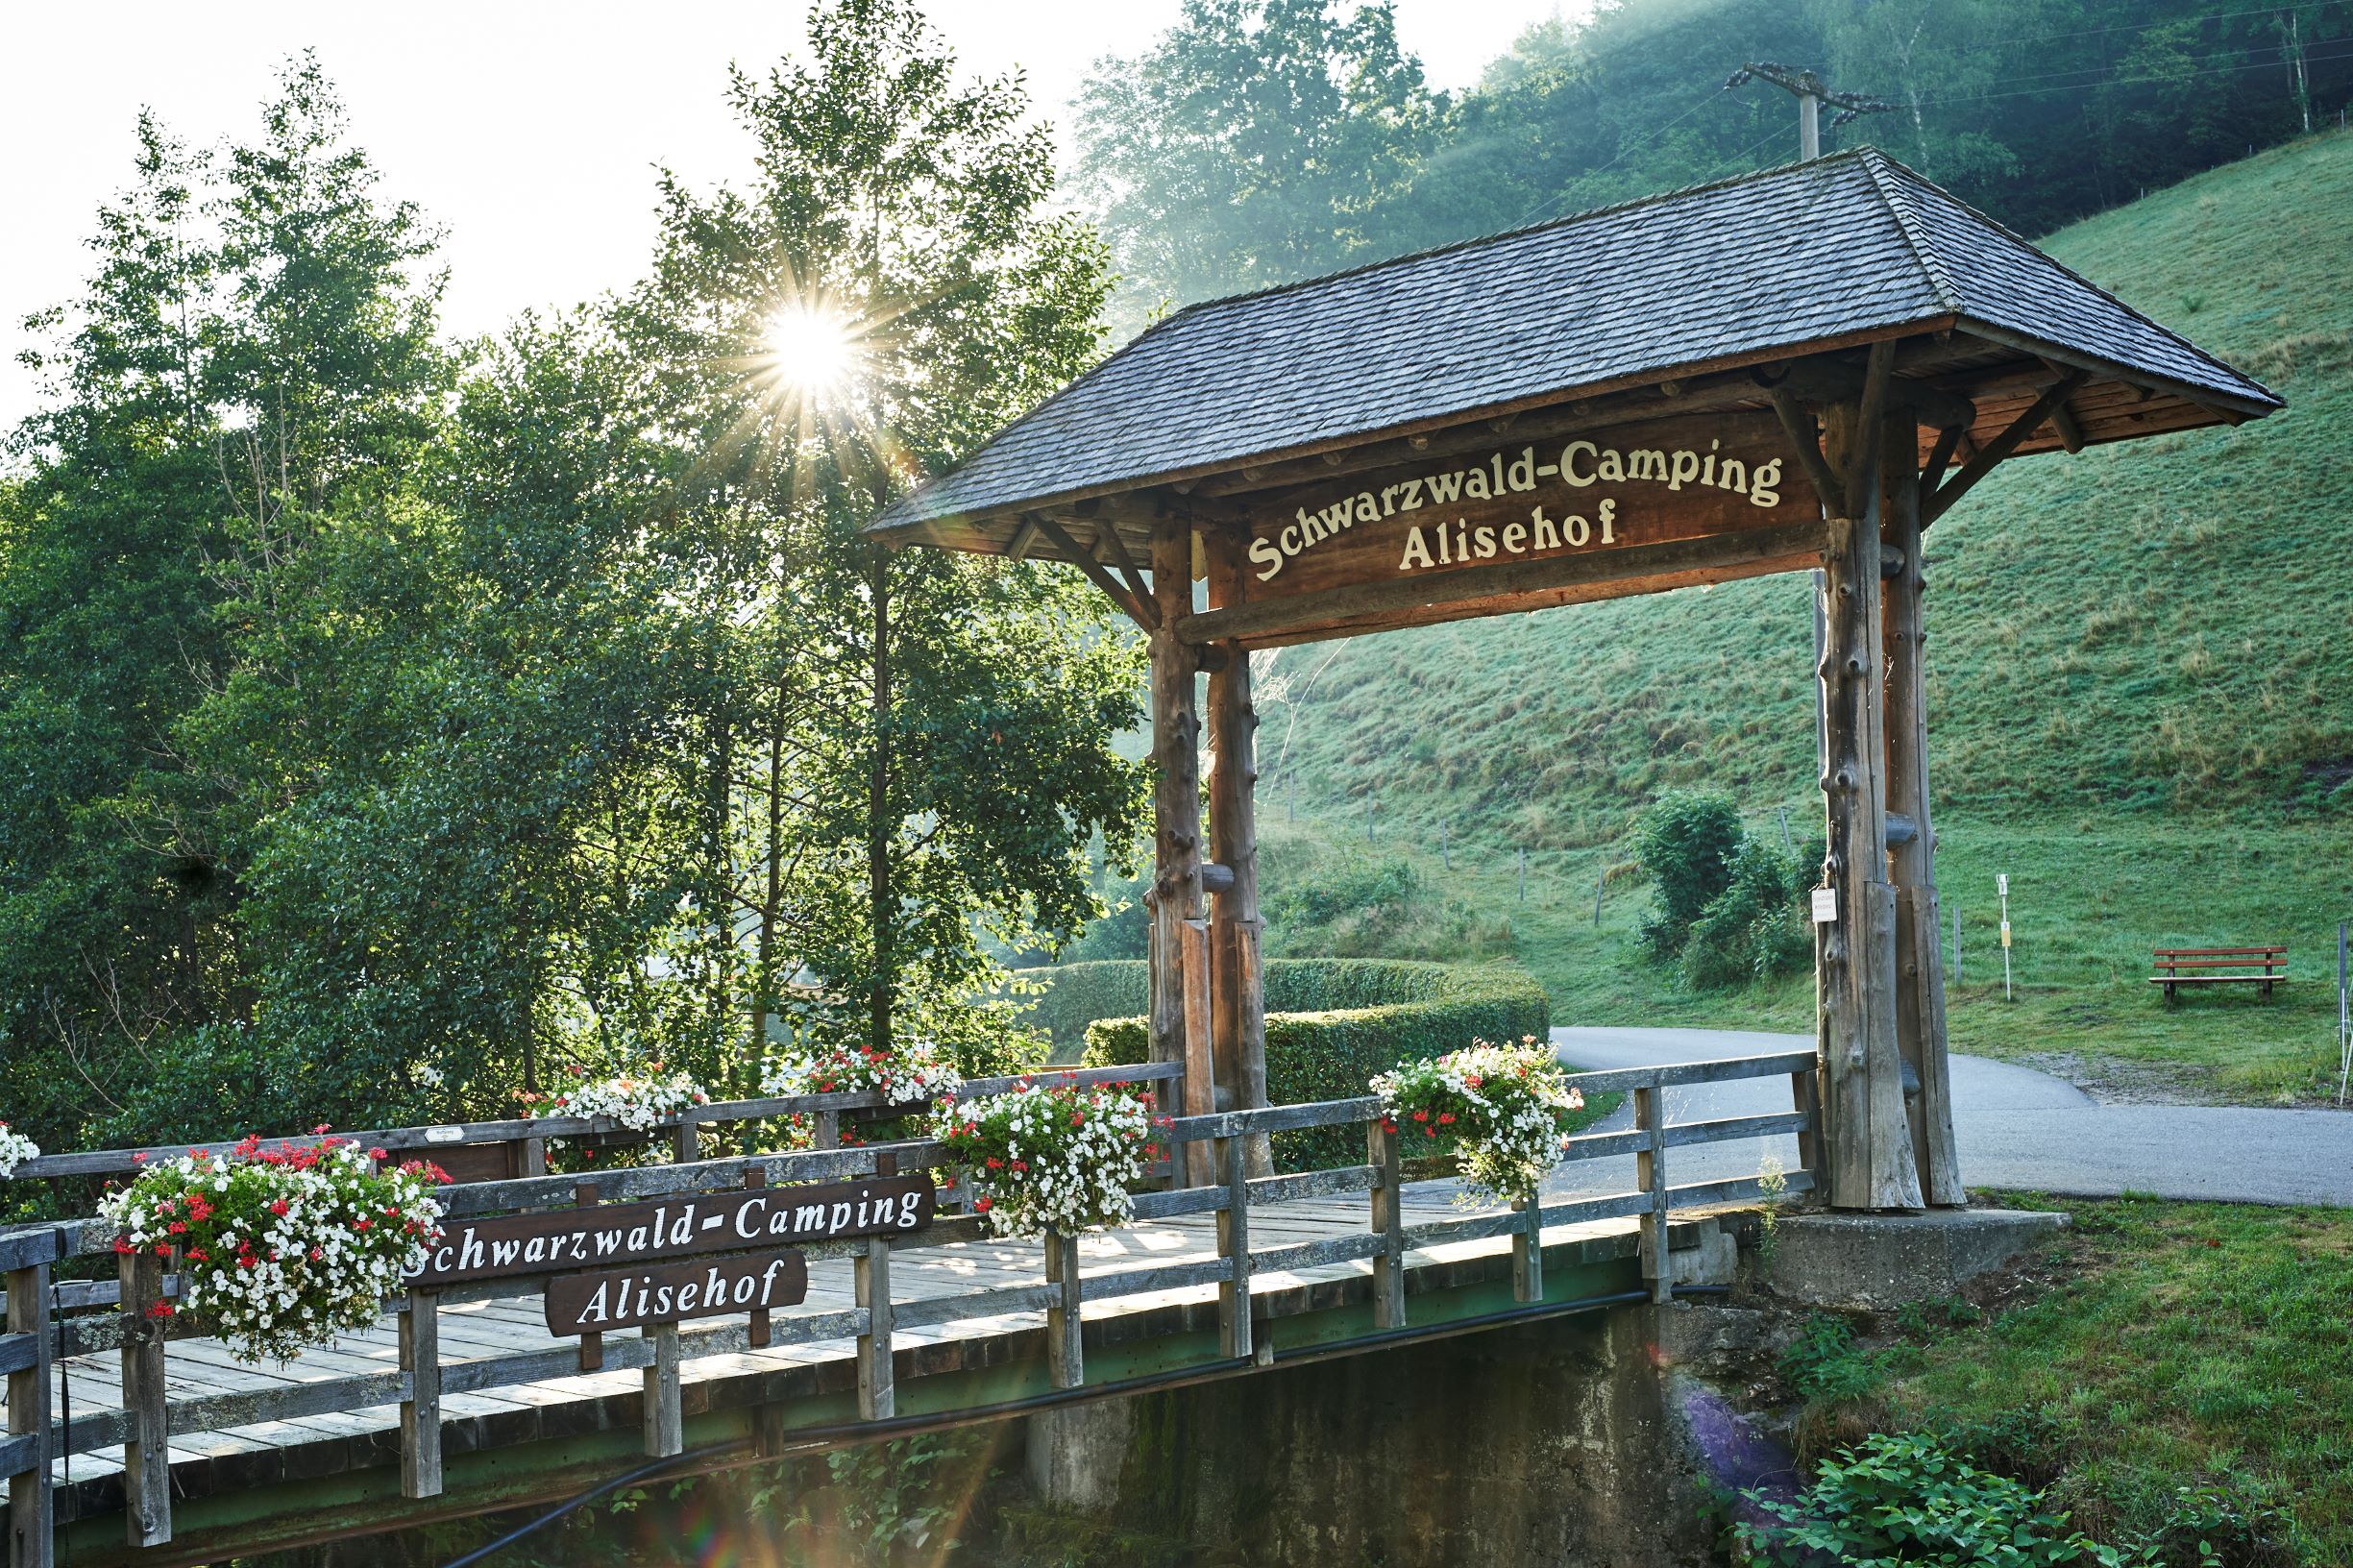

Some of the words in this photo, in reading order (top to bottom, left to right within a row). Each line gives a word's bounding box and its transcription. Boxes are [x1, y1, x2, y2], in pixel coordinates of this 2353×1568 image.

[1248, 439, 1782, 581] Schwarzwald-Camping
[1399, 498, 1616, 570] Alisehof
[576, 1260, 785, 1324] Alisehof
